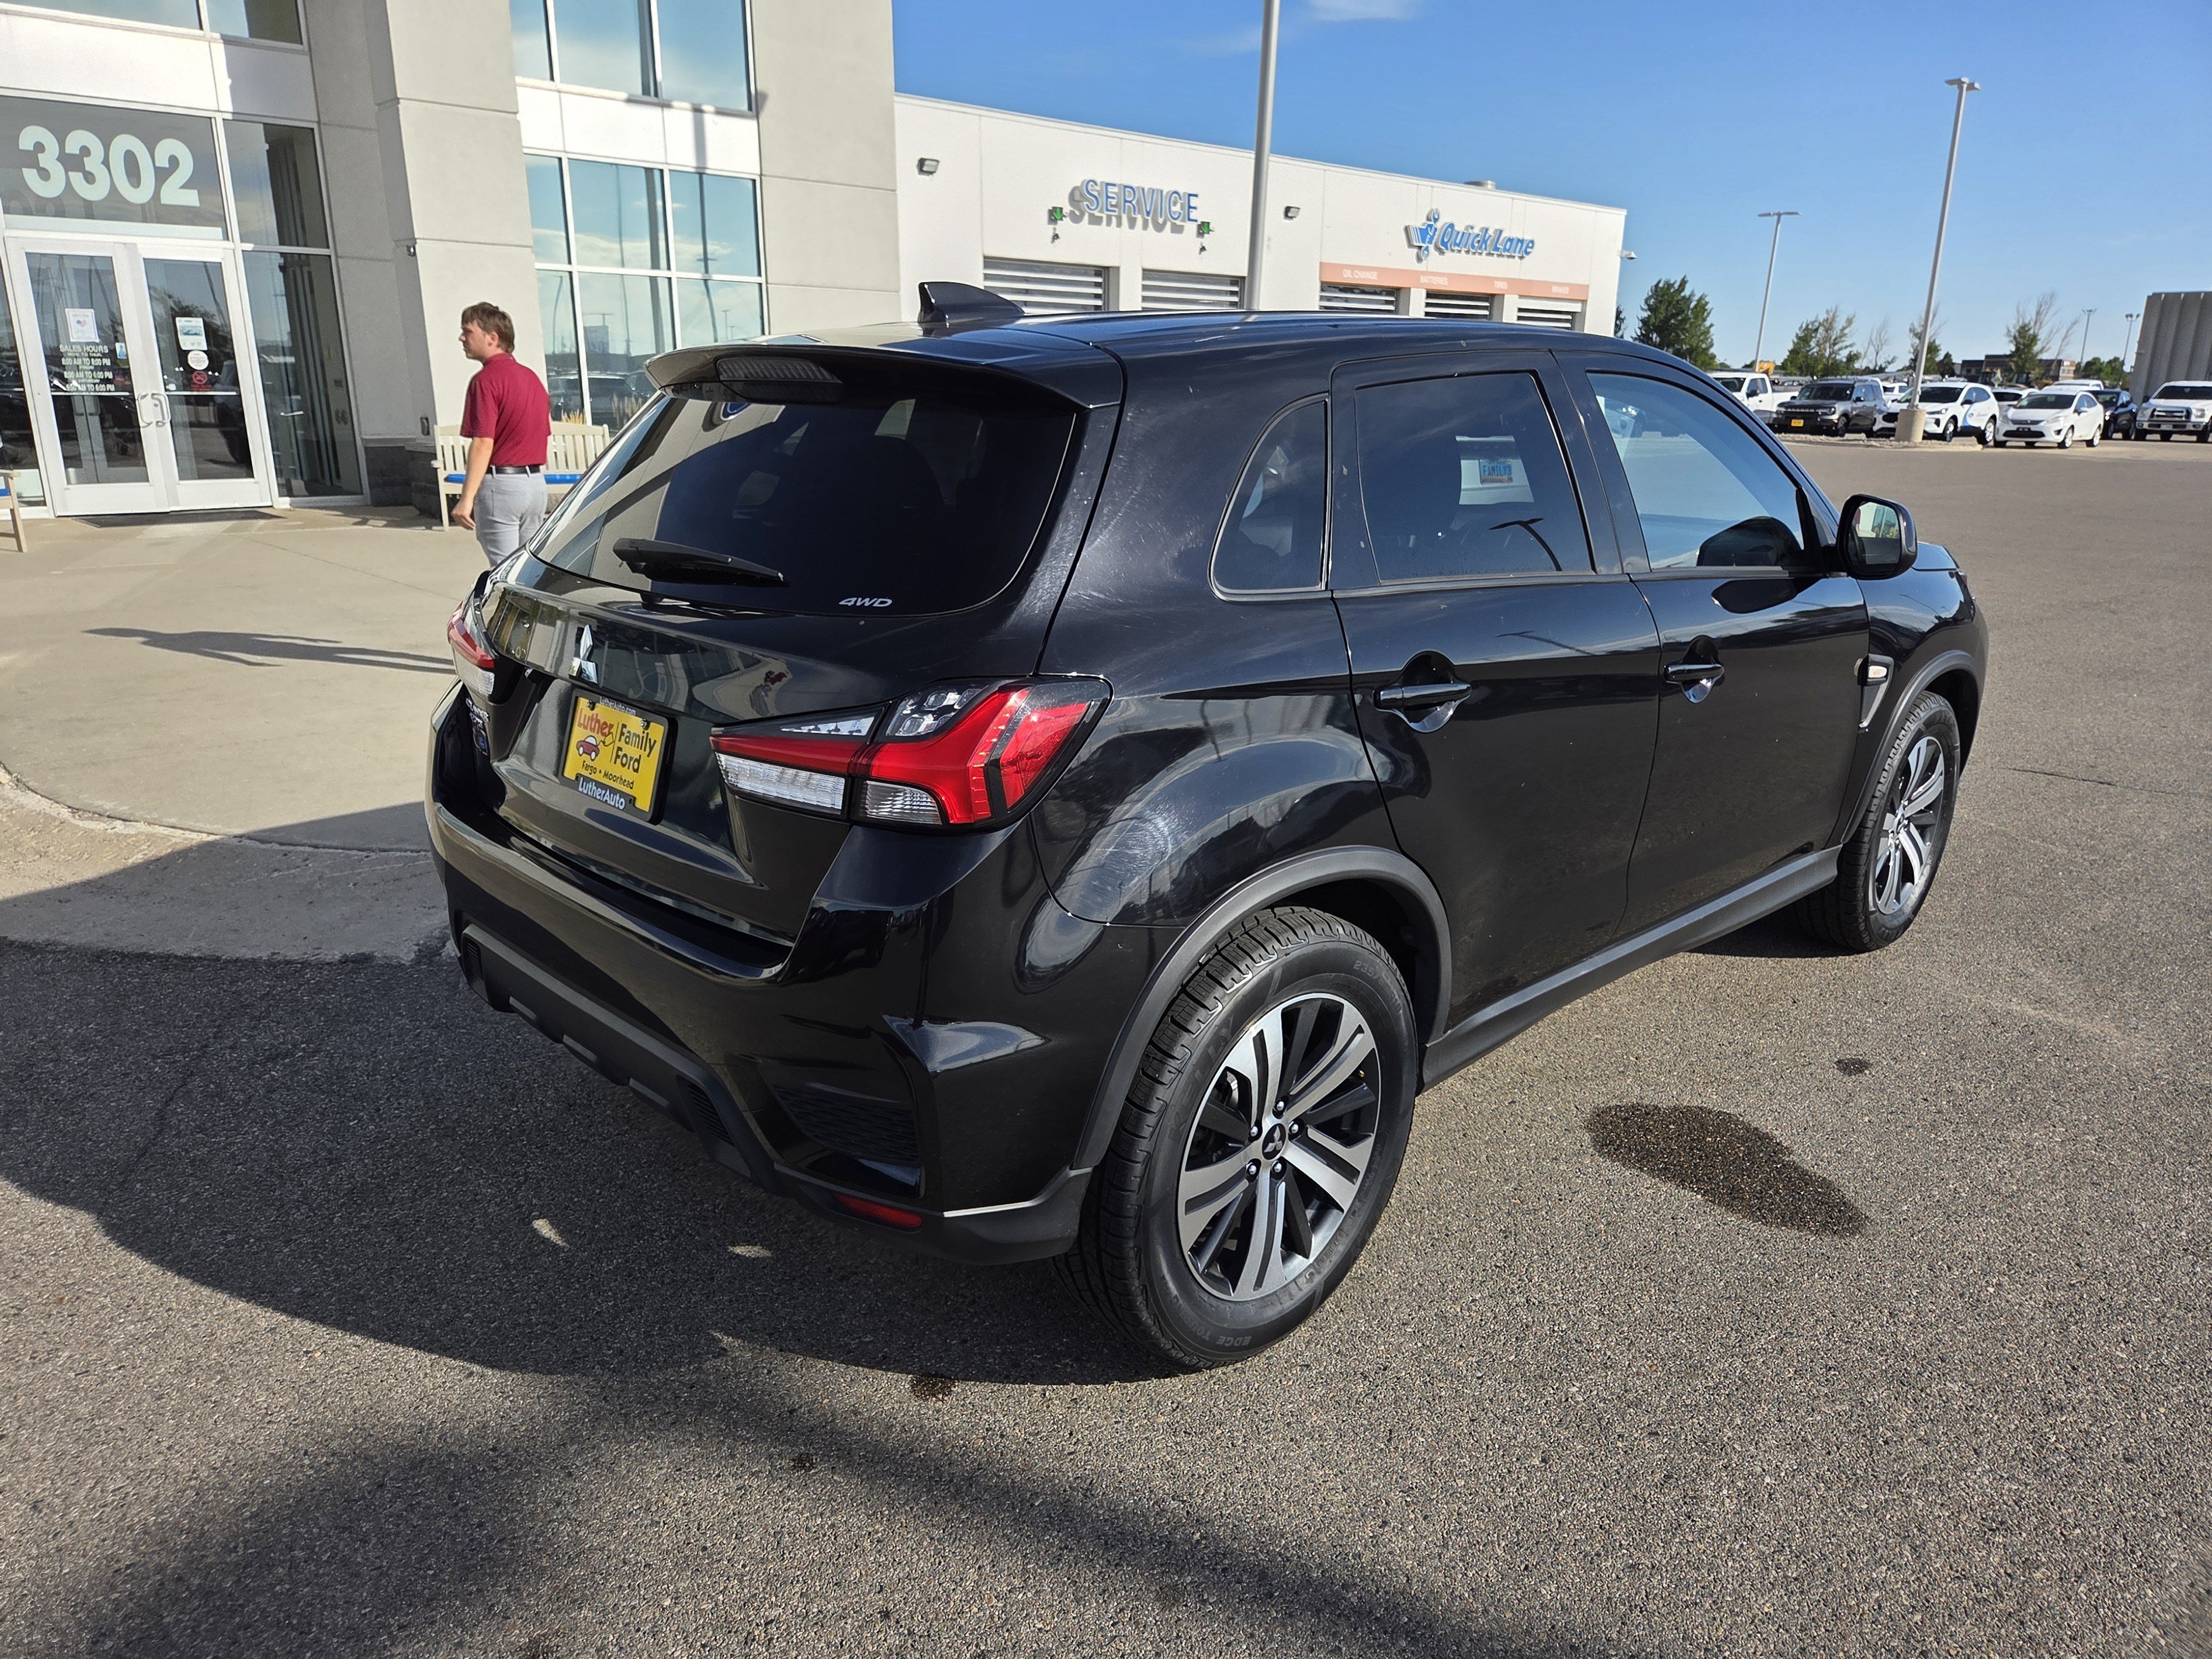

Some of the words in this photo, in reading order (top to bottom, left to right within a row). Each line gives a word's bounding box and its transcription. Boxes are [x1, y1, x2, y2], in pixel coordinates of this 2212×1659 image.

[18, 125, 200, 207] 3302
[1083, 178, 1199, 224] SERVICE
[1439, 222, 1492, 253] Quick
[1492, 228, 1535, 257] Lane
[1342, 269, 1353, 278] OIL
[1354, 269, 1378, 280] CHANGE
[1420, 275, 1449, 286] BATTERIES
[1494, 280, 1508, 290] TIRES
[1551, 285, 1570, 295] BRAKES
[59, 344, 82, 353] SALES
[84, 345, 109, 353] HOURS
[838, 597, 893, 607] 4WD
[599, 696, 637, 716] LutherAuto.com
[577, 708, 614, 737] Luther
[619, 723, 657, 758] Family
[614, 746, 641, 774] Ford
[582, 760, 597, 775] Fargo
[603, 769, 635, 790] Moorhead
[578, 777, 626, 810] LutherAuto
[1215, 1335, 1253, 1347] EDGE
